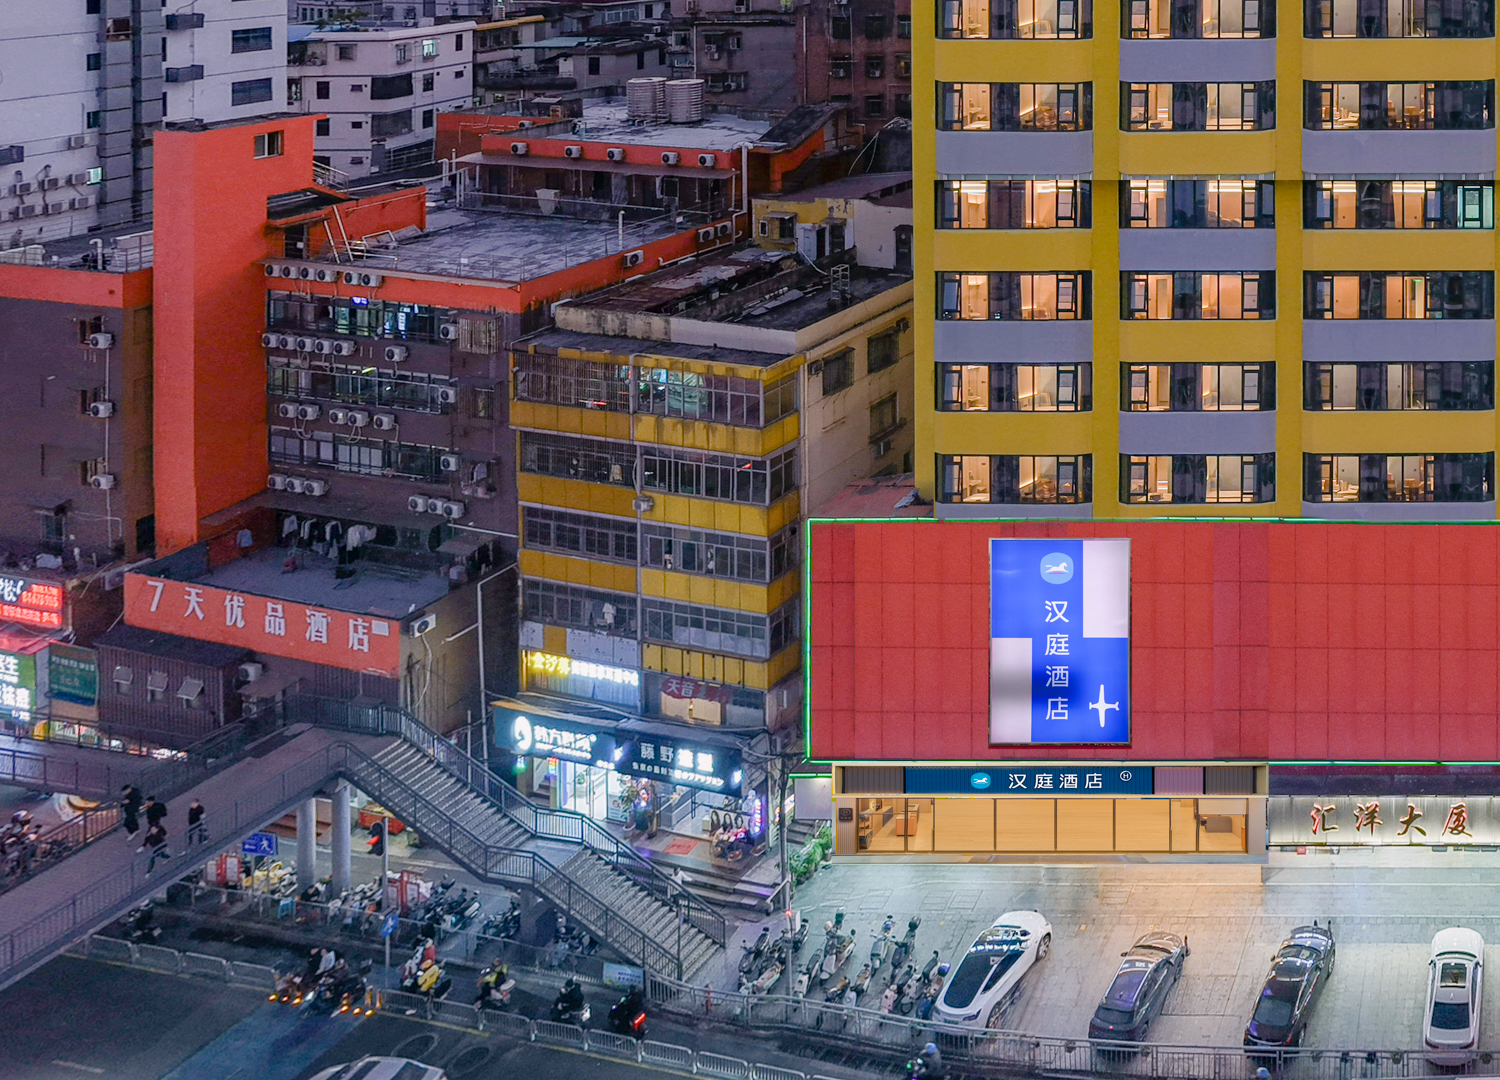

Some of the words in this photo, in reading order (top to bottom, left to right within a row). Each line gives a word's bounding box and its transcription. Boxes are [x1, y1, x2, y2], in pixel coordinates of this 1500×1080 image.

[146, 580, 370, 653] 7天优品酒店
[1045, 600, 1070, 720] 汉庭酒店
[1008, 773, 1102, 789] 汉庭酒店
[1310, 801, 1474, 837] 汇洋大厦
